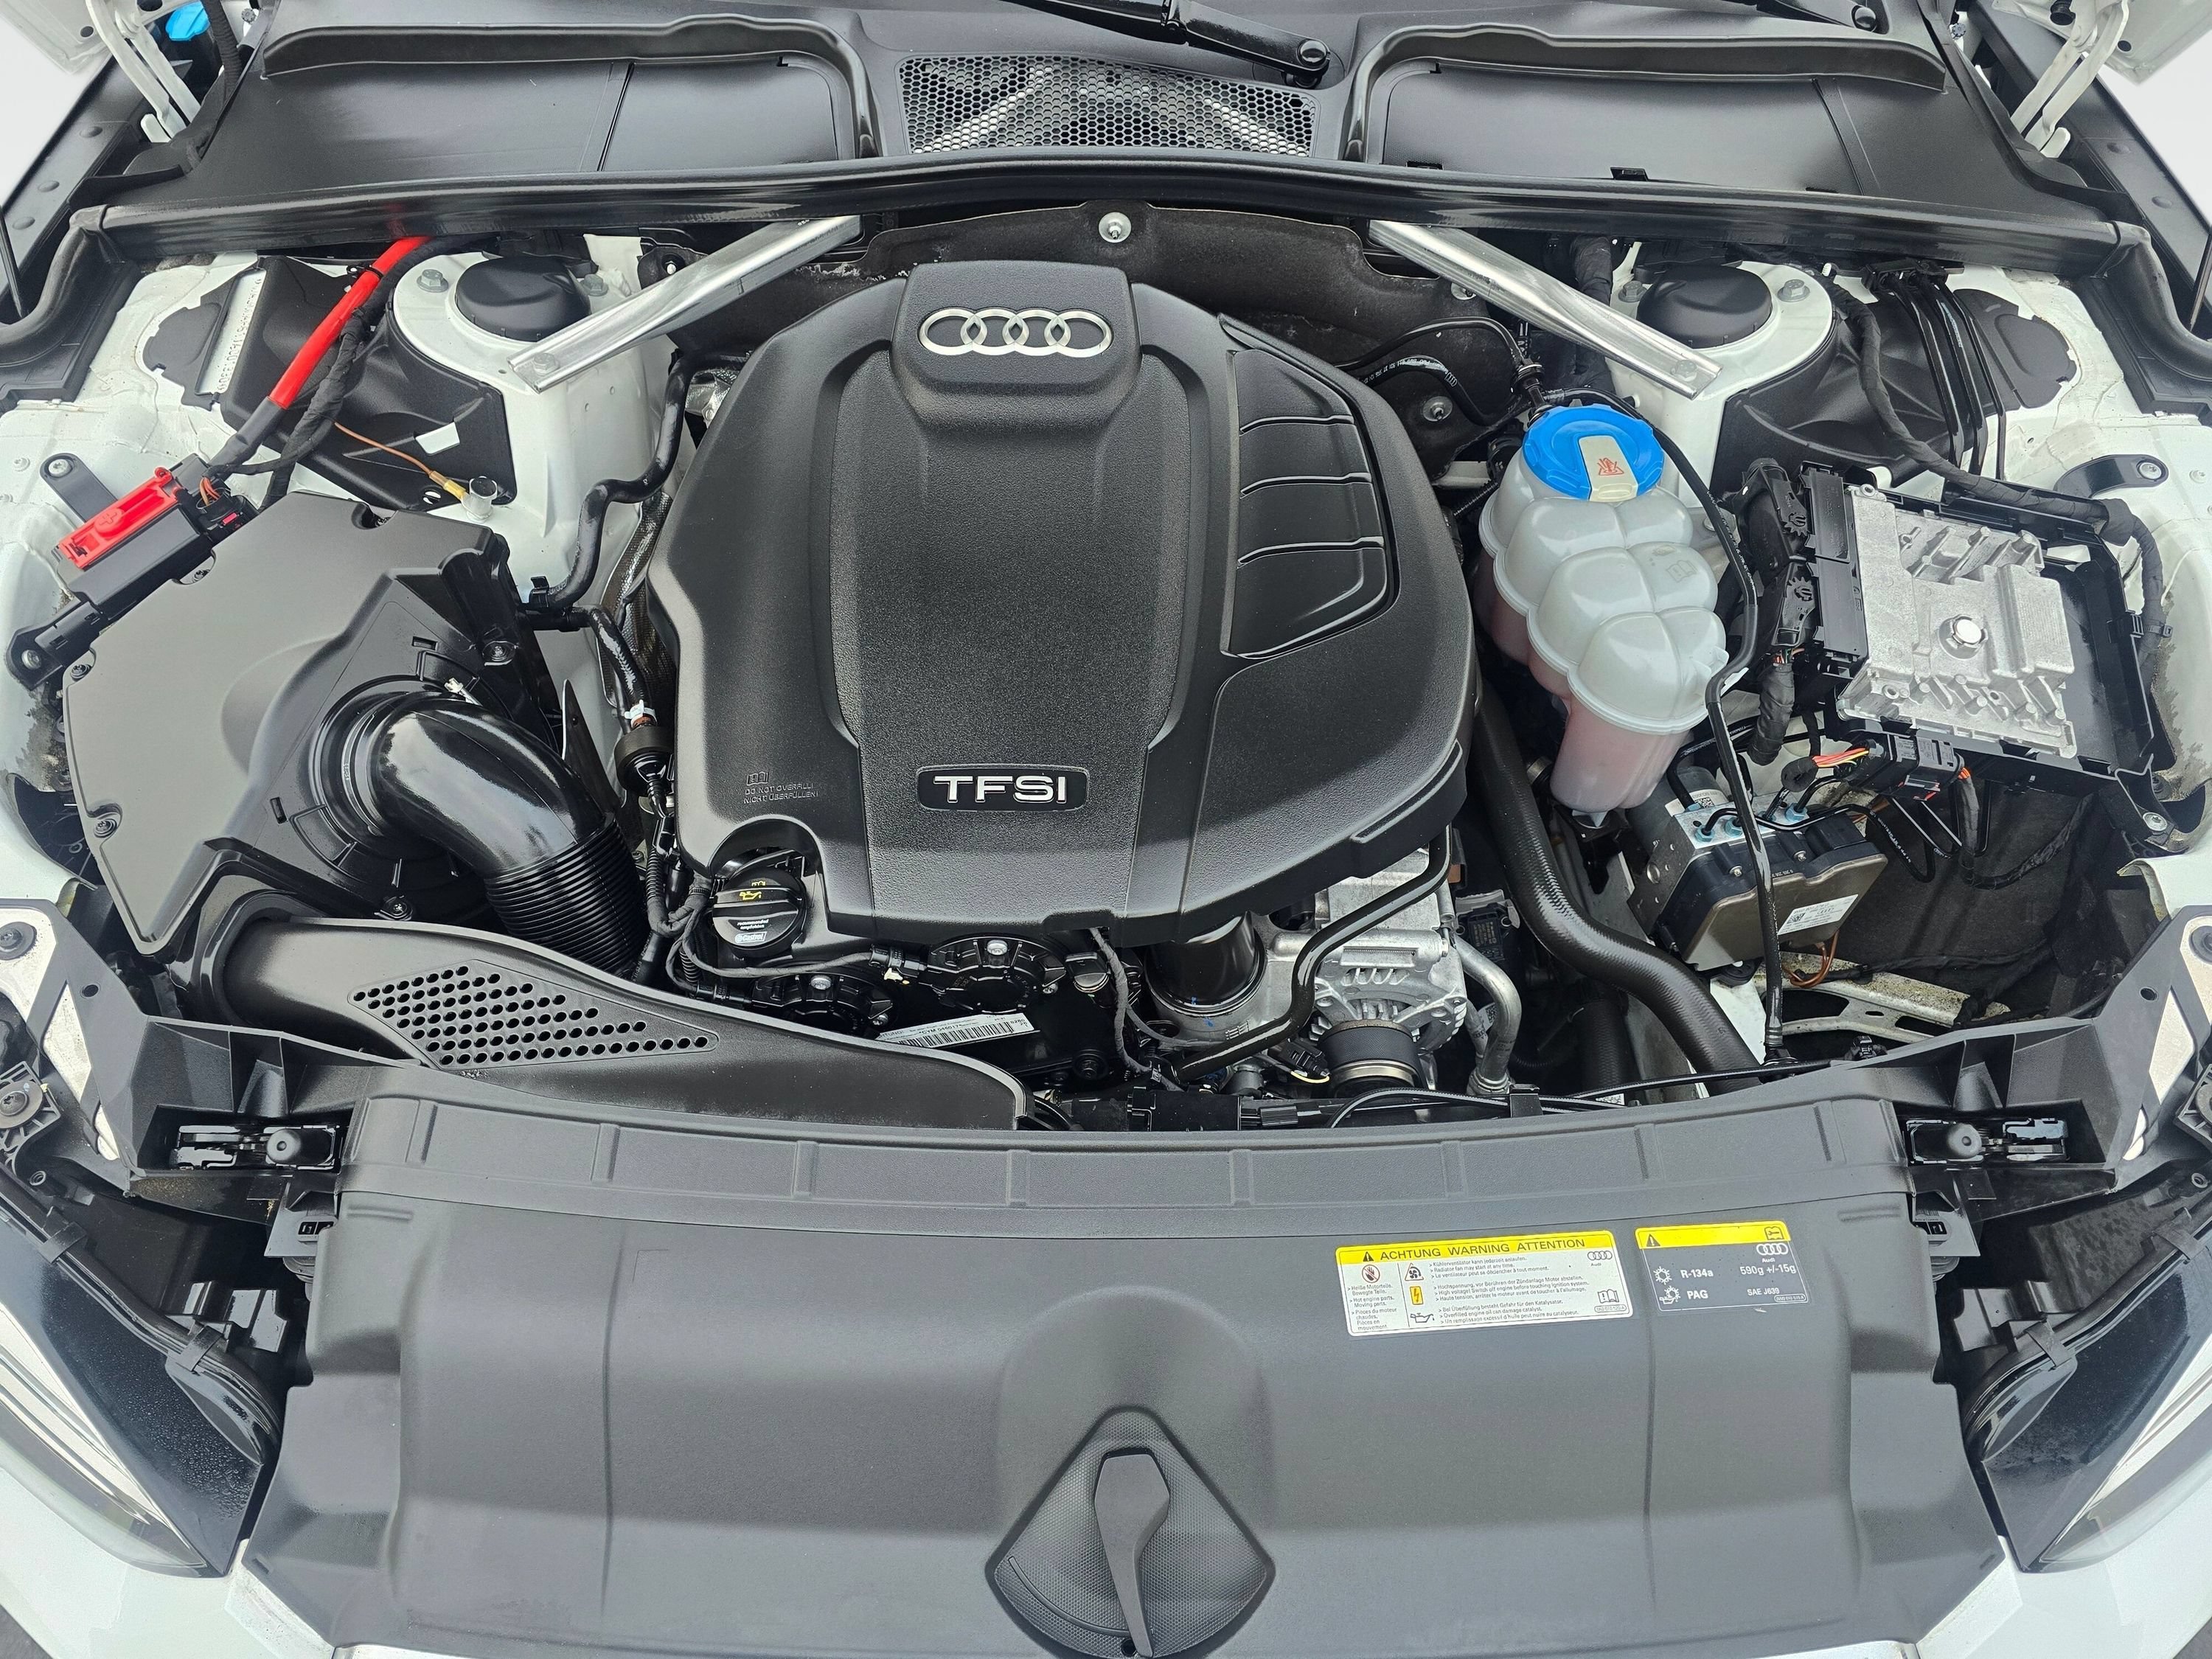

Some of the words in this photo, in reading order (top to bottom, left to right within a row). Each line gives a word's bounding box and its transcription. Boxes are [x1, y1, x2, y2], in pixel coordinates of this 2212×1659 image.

[933, 775, 1067, 804] TFSI
[743, 795, 768, 804] NICHT
[1380, 1248, 1441, 1260] ACHTUNG
[1447, 1243, 1510, 1256] WARNING
[1517, 1239, 1585, 1251] ATTENTION
[1680, 1268, 1714, 1279] R-134a
[1739, 1265, 1764, 1276] 590g
[1766, 1264, 1796, 1274] +/-15g
[1686, 1290, 1708, 1300] PAG
[1747, 1288, 1761, 1296] SAE
[1763, 1287, 1780, 1295] J639
